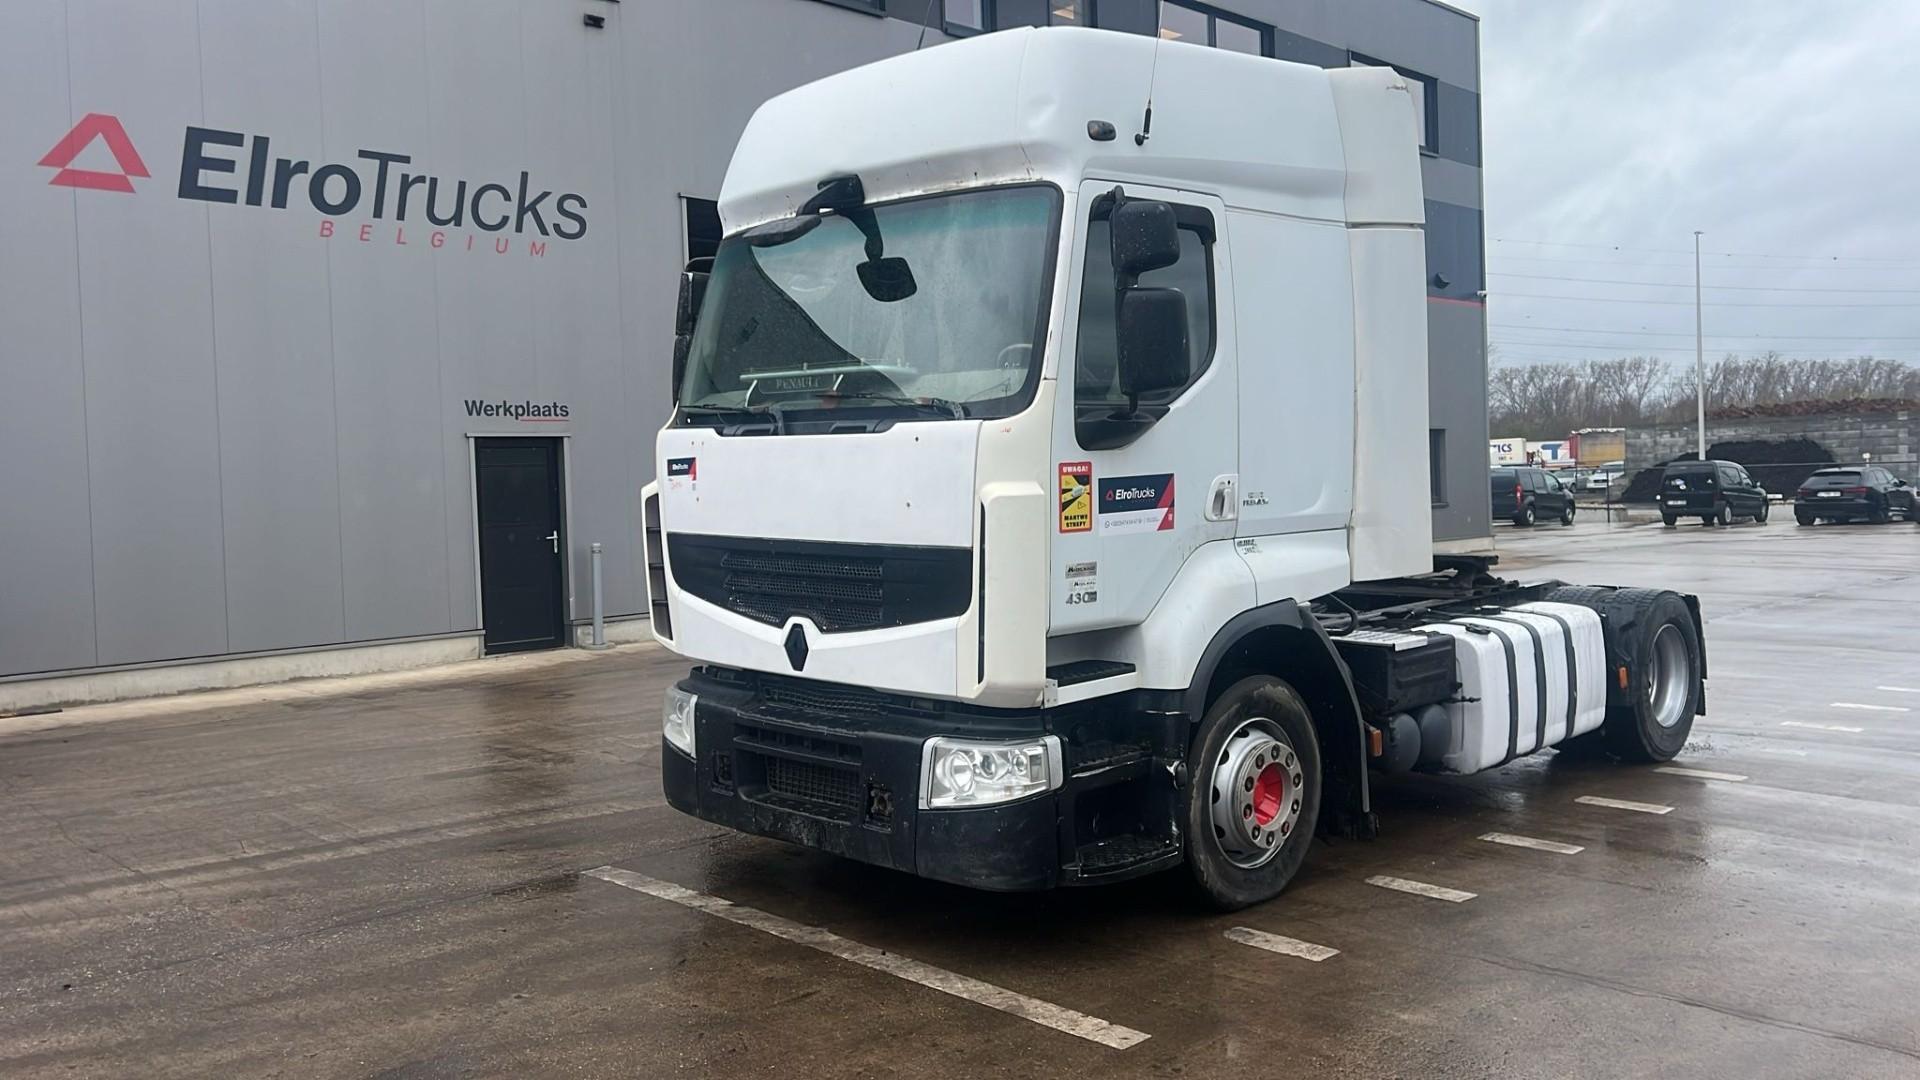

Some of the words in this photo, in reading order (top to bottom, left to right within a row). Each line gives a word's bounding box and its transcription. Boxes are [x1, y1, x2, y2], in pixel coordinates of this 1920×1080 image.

[178, 126, 588, 240] ElroTrucks
[319, 219, 547, 258] BELGIUM
[464, 399, 570, 421] Werkplaats
[1115, 487, 1155, 500] ElroTrucks
[1065, 592, 1090, 605] 430
